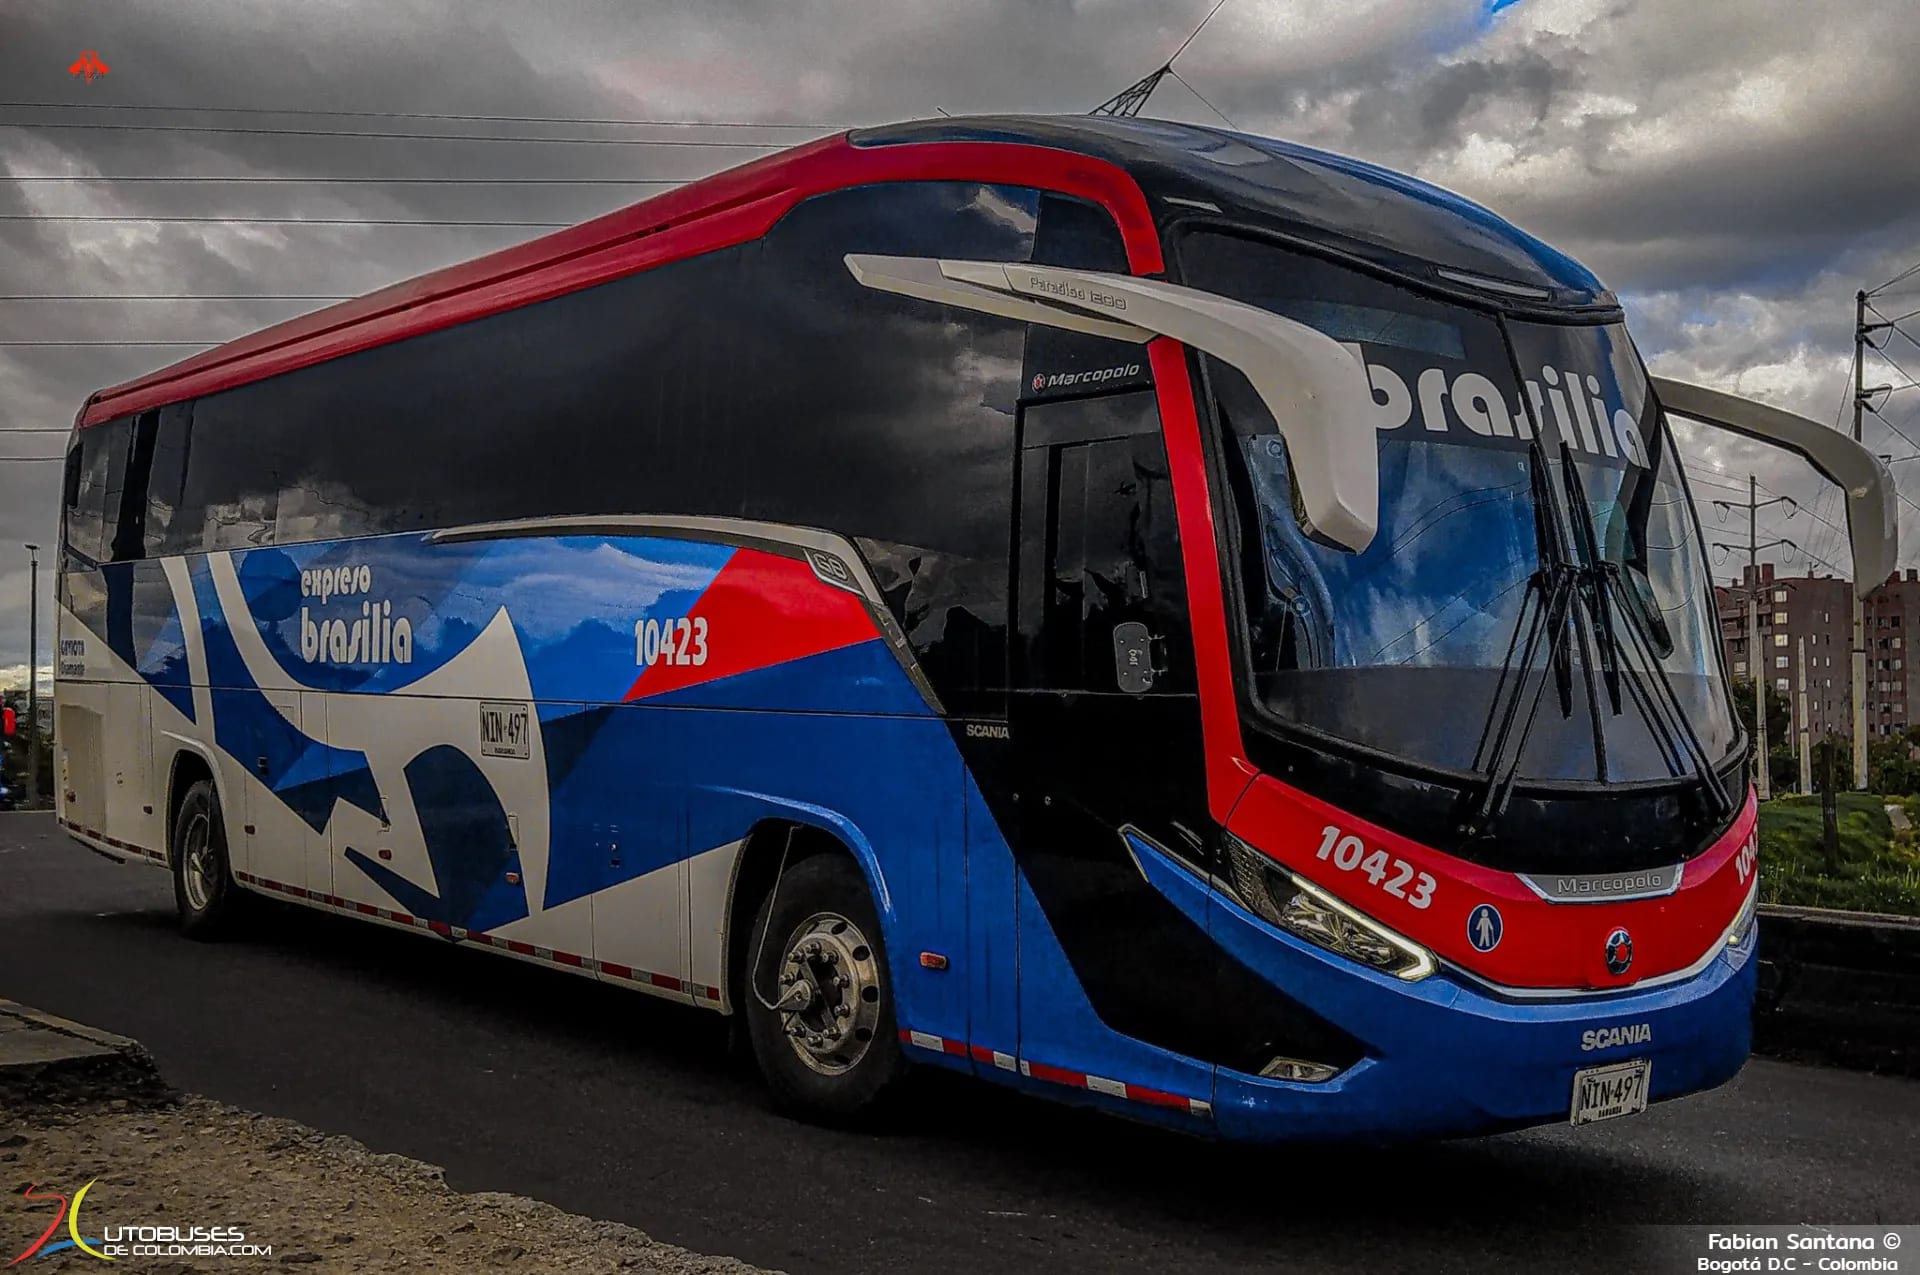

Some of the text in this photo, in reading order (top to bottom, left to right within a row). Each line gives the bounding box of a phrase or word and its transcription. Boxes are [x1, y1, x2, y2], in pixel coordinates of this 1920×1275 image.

[1048, 363, 1140, 388] Marcopolo
[301, 565, 371, 604] expreso
[301, 599, 412, 664] brasilia
[634, 616, 708, 666] 10423
[966, 724, 1010, 739] SCANIA
[1315, 825, 1437, 910] 10423
[1557, 872, 1662, 894] Marcopolo
[1581, 1023, 1652, 1051] SCANIA
